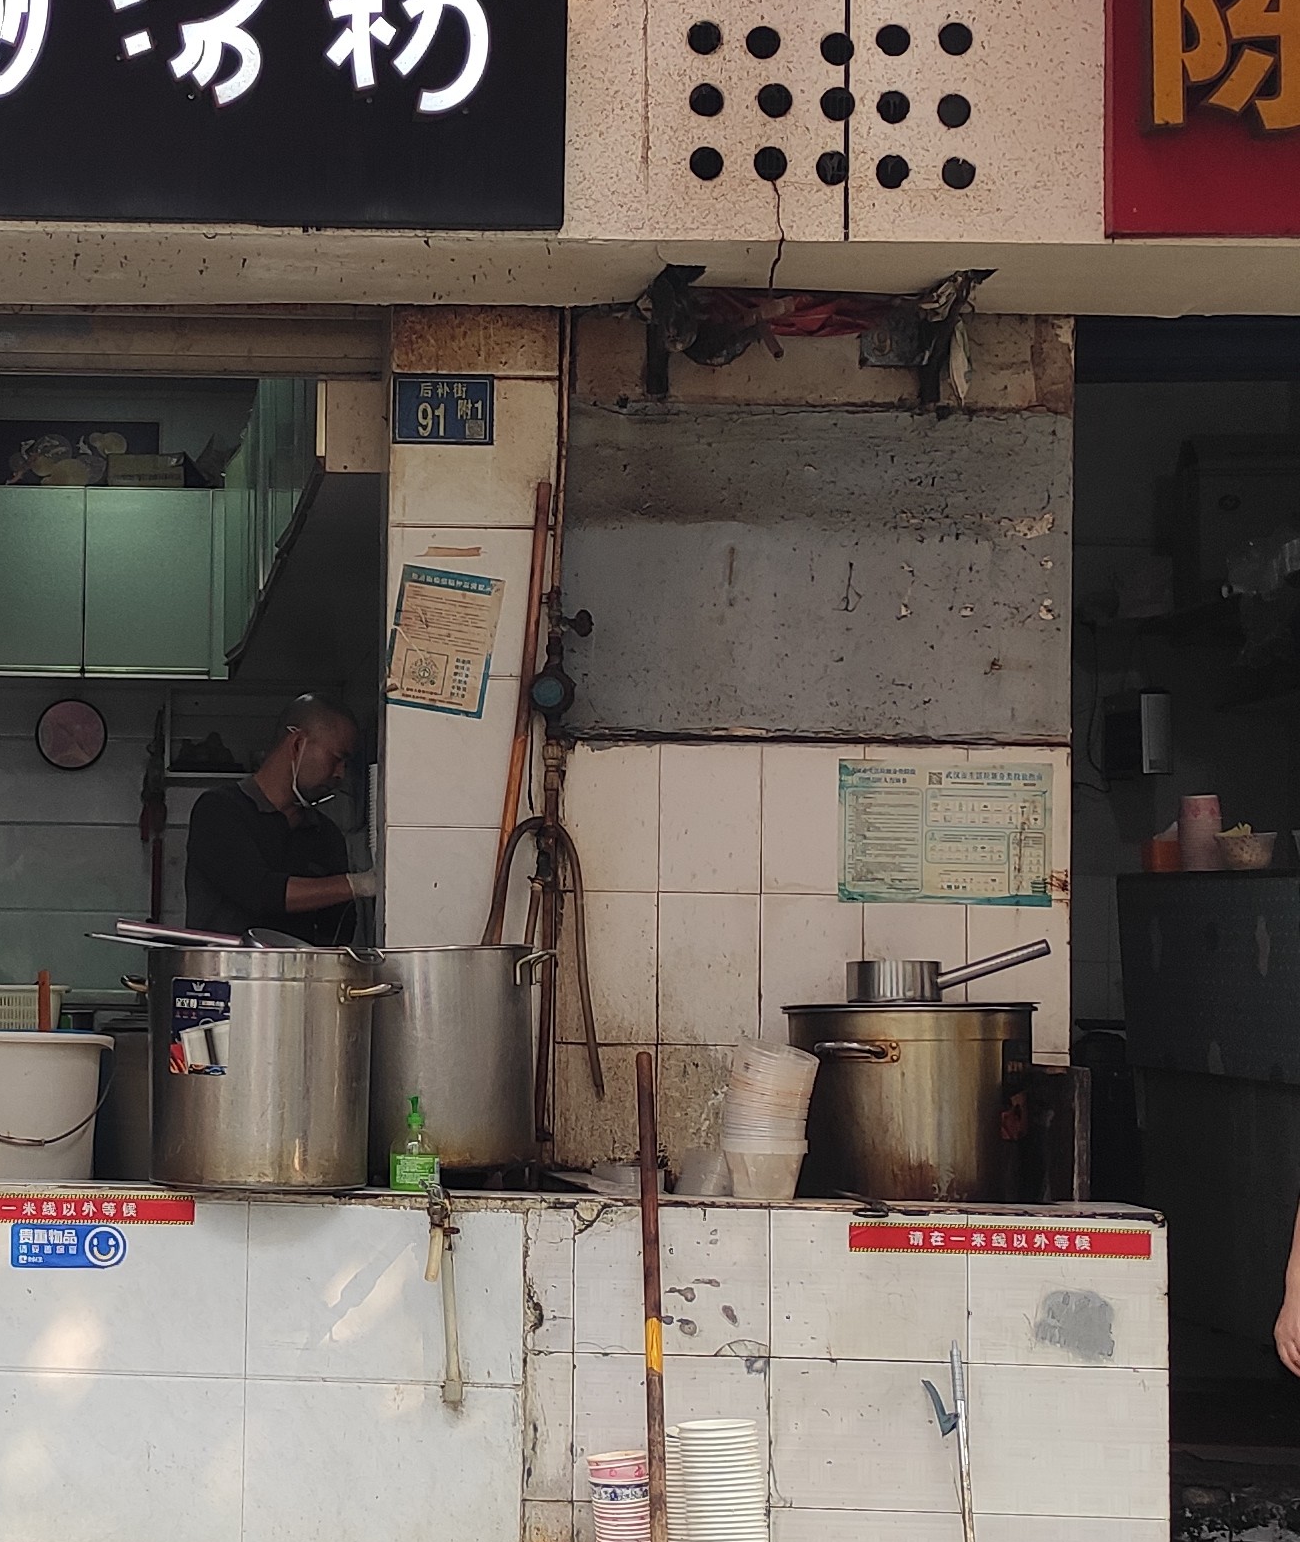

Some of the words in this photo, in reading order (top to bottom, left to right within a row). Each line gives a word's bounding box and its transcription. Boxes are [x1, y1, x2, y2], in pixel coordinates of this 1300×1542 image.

[420, 382, 466, 399] 后补街
[417, 402, 445, 437] 91
[457, 399, 483, 420] 附1
[19, 1228, 78, 1245] 贵重物品
[908, 1230, 1092, 1251] 请在一米线以外等候
